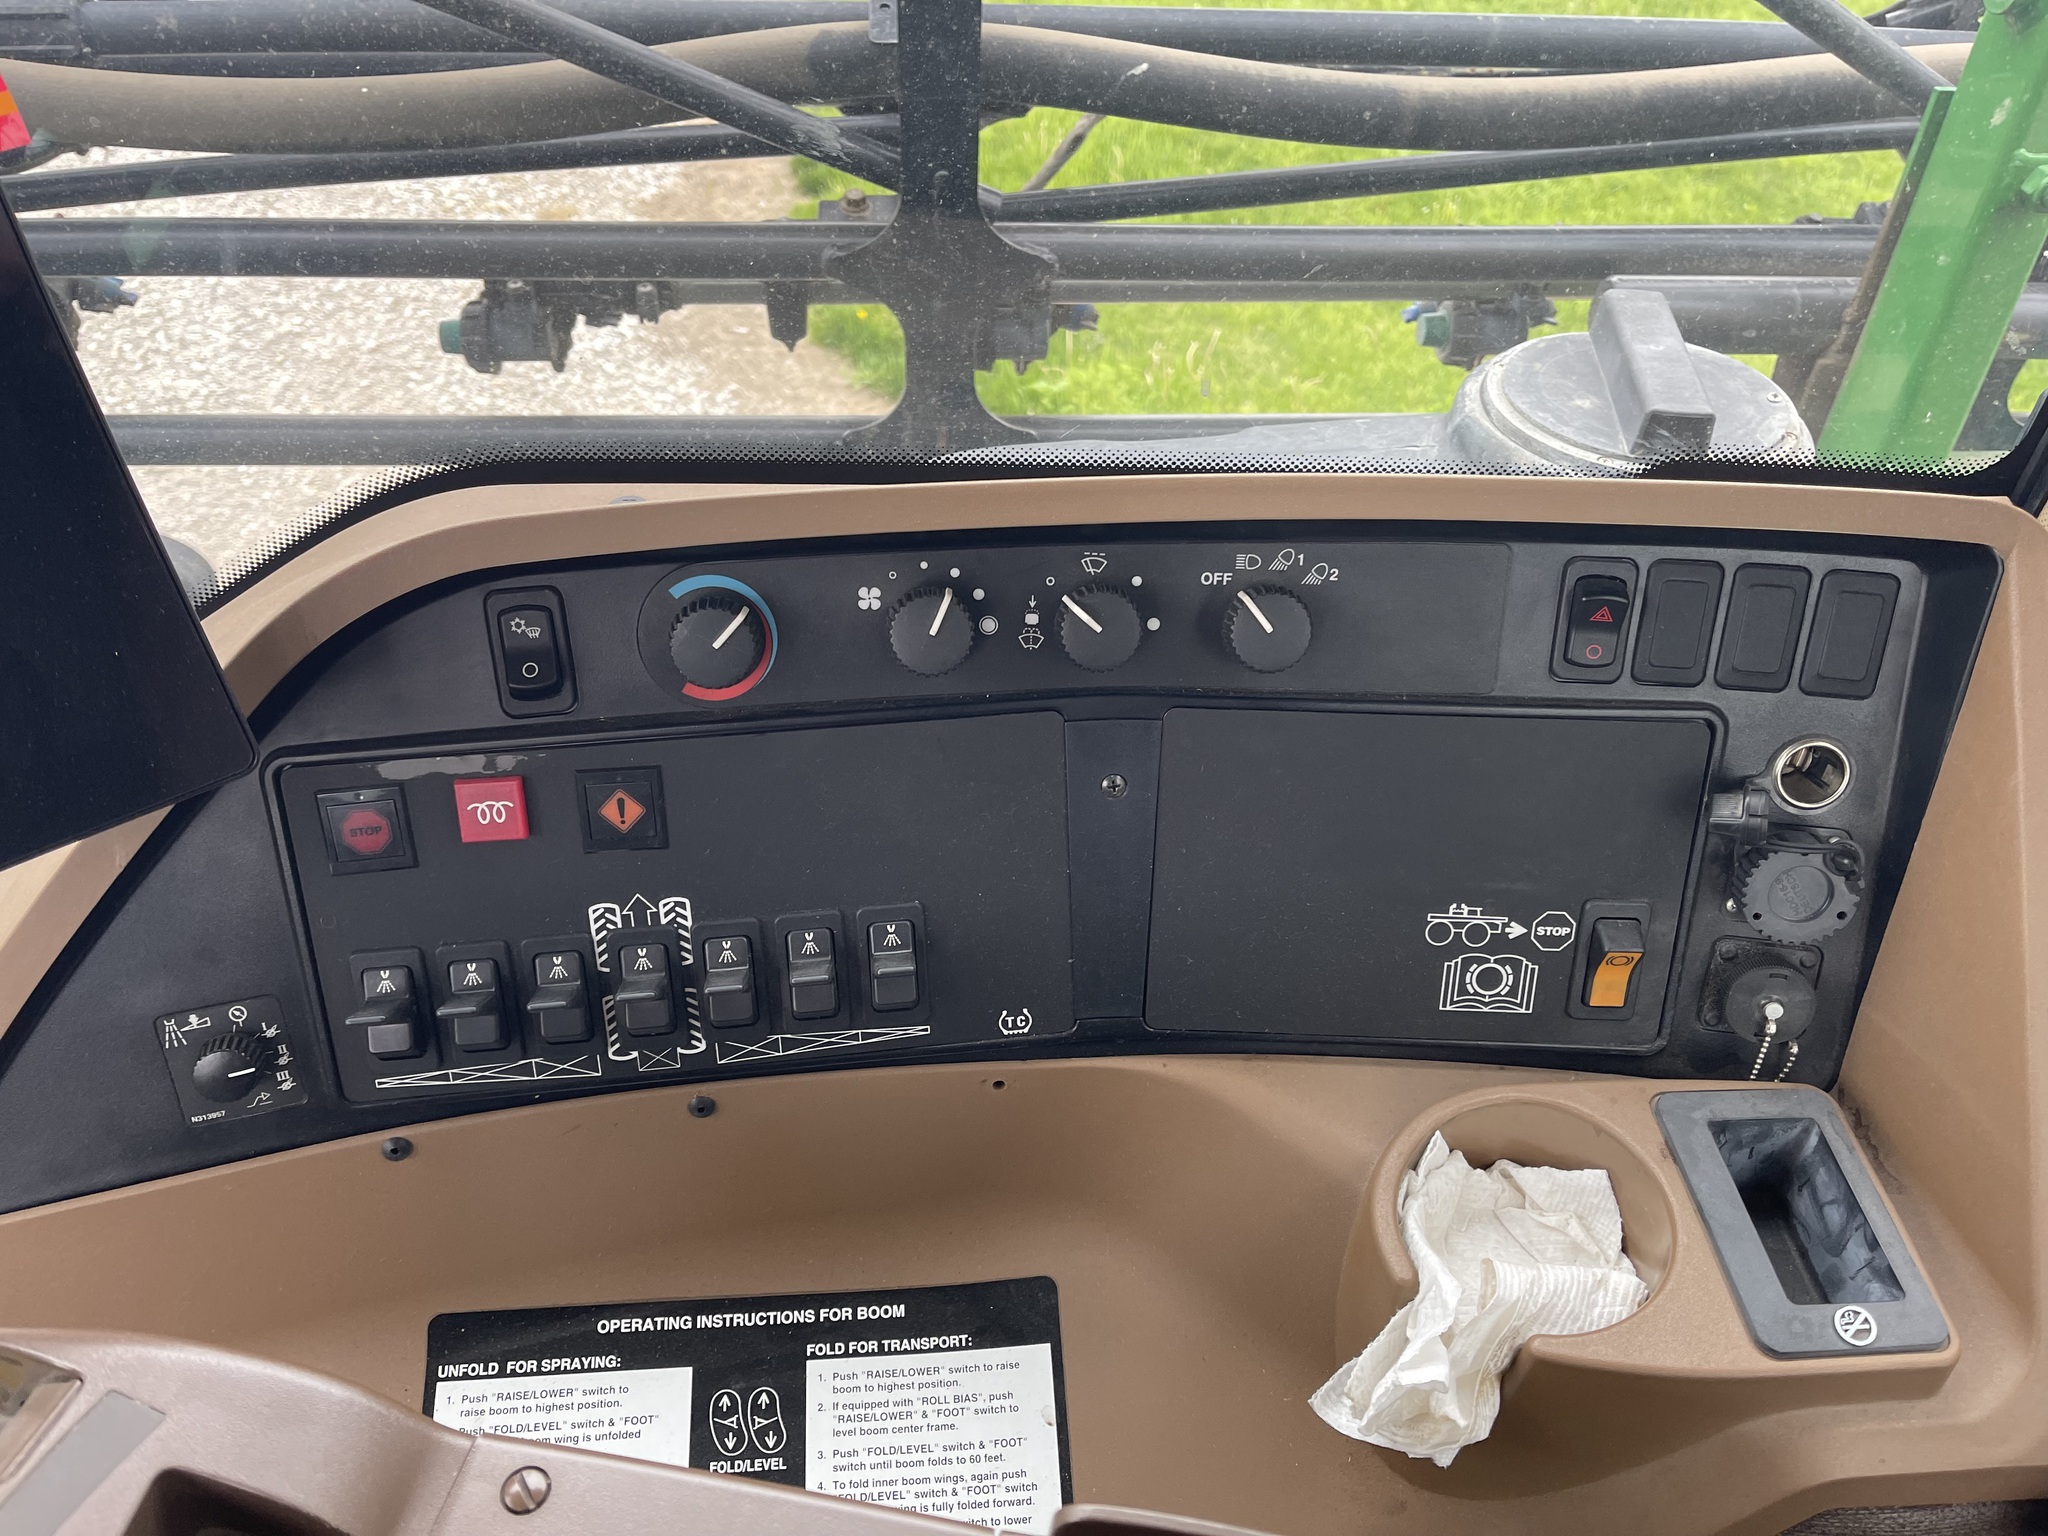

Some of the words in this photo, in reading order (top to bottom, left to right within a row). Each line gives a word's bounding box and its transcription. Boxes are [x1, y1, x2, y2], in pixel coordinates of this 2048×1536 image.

[1297, 553, 1304, 566] 1
[1200, 572, 1233, 585] OFF
[1329, 568, 1339, 581] 2
[350, 826, 382, 837] STOP
[1536, 926, 1571, 936] STOP
[191, 1110, 226, 1123] N313957
[597, 1316, 692, 1334] OPERATING
[696, 1310, 815, 1329] INSTRUCTIONS
[820, 1308, 853, 1322] FOR
[857, 1304, 905, 1320] BOOM
[807, 1344, 844, 1356] FOLD
[849, 1341, 878, 1353] FOR
[882, 1334, 972, 1351] TRANSPORT:
[438, 1362, 499, 1378] UNFOLD
[507, 1359, 537, 1374] FOR
[541, 1355, 621, 1372] SPRAYING:
[818, 1374, 826, 1382] 1.
[833, 1371, 858, 1381] Push
[862, 1366, 944, 1379] "RAISE/LOWER"
[948, 1363, 980, 1374] switch
[983, 1363, 993, 1372] to
[996, 1361, 1019, 1370] raise
[446, 1396, 454, 1405] 1.
[461, 1393, 488, 1404] Push
[492, 1388, 579, 1402] "RAISE/LOWER"
[582, 1385, 615, 1396] switch
[619, 1385, 629, 1394] to
[833, 1384, 861, 1394] boom
[865, 1384, 874, 1392] to
[878, 1381, 915, 1394] highest
[918, 1379, 961, 1392] position.
[460, 1407, 485, 1417] raise
[489, 1403, 518, 1415] boom
[521, 1404, 532, 1413] to
[535, 1400, 574, 1415] highest
[577, 1399, 622, 1412] position.
[818, 1403, 826, 1411] 2.
[833, 1401, 839, 1410] If
[842, 1399, 890, 1412] equipped
[893, 1398, 913, 1407] with
[917, 1396, 950, 1405] "ROLL
[989, 1391, 1013, 1403] push
[833, 1411, 917, 1424] "RAISE/LOWER"
[922, 1410, 928, 1419] &
[932, 1407, 970, 1418] "FOOT"
[974, 1405, 1006, 1415] switch
[1009, 1404, 1019, 1412] to
[489, 1420, 567, 1435] "FOLD/LEVEL"
[570, 1418, 604, 1430] switch
[608, 1417, 615, 1427] &
[619, 1415, 659, 1426] "FOOT"
[833, 1428, 856, 1437] level
[860, 1425, 888, 1435] boom
[892, 1425, 924, 1434] center
[927, 1422, 958, 1432] frame.
[554, 1434, 579, 1446] wing
[582, 1433, 592, 1442] is
[595, 1430, 641, 1441] unfolded
[817, 1451, 826, 1459] 3.
[833, 1449, 859, 1459] Push
[863, 1443, 939, 1457] "FOLD/LEVEL"
[942, 1441, 975, 1452] switch
[979, 1440, 985, 1449] &
[989, 1437, 1027, 1448] "FOOT"
[710, 1458, 787, 1473] FOLD/LEVEL
[833, 1462, 866, 1472] switch
[870, 1460, 892, 1470] until
[896, 1458, 924, 1469] boom
[928, 1456, 953, 1466] folds
[956, 1456, 966, 1464] to
[969, 1455, 981, 1464] 60
[984, 1453, 1006, 1462] feet.
[817, 1482, 826, 1491] 4.
[833, 1481, 846, 1490] To
[849, 1478, 869, 1489] fold
[872, 1476, 898, 1487] inner
[902, 1475, 930, 1486] boom
[934, 1474, 967, 1486] wings,
[971, 1471, 998, 1483] again
[1001, 1469, 1027, 1481] push
[914, 1488, 948, 1498] switch
[951, 1487, 958, 1496] &
[962, 1484, 1001, 1495] "FOOT"
[1004, 1482, 1038, 1493] switch
[920, 1503, 928, 1511] is
[932, 1502, 954, 1514] fully
[957, 1499, 989, 1509] folded
[993, 1496, 1035, 1508] forward.
[990, 1516, 1000, 1525] to
[1004, 1515, 1032, 1525] lower
